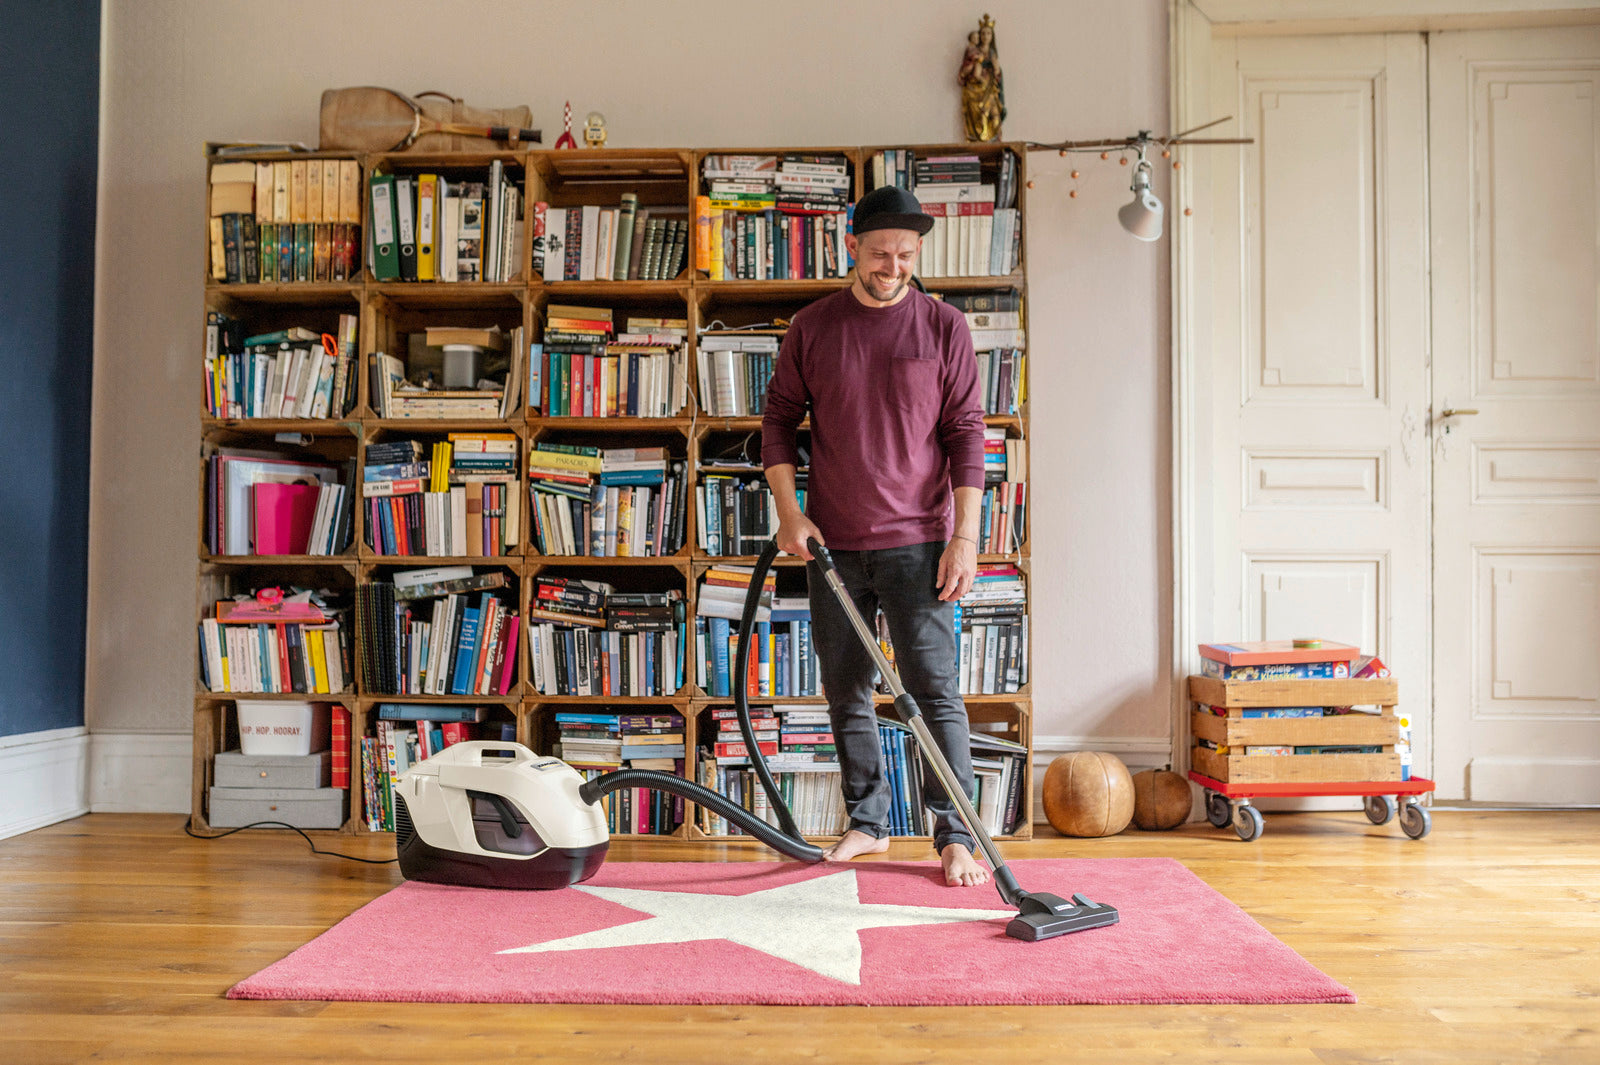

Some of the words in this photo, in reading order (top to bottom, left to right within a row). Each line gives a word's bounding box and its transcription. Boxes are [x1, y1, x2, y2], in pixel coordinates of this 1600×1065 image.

[555, 457, 589, 467] PARADIES
[241, 725, 254, 736] HIP.
[256, 726, 272, 736] HOP.
[273, 726, 303, 736] HOORAY.
